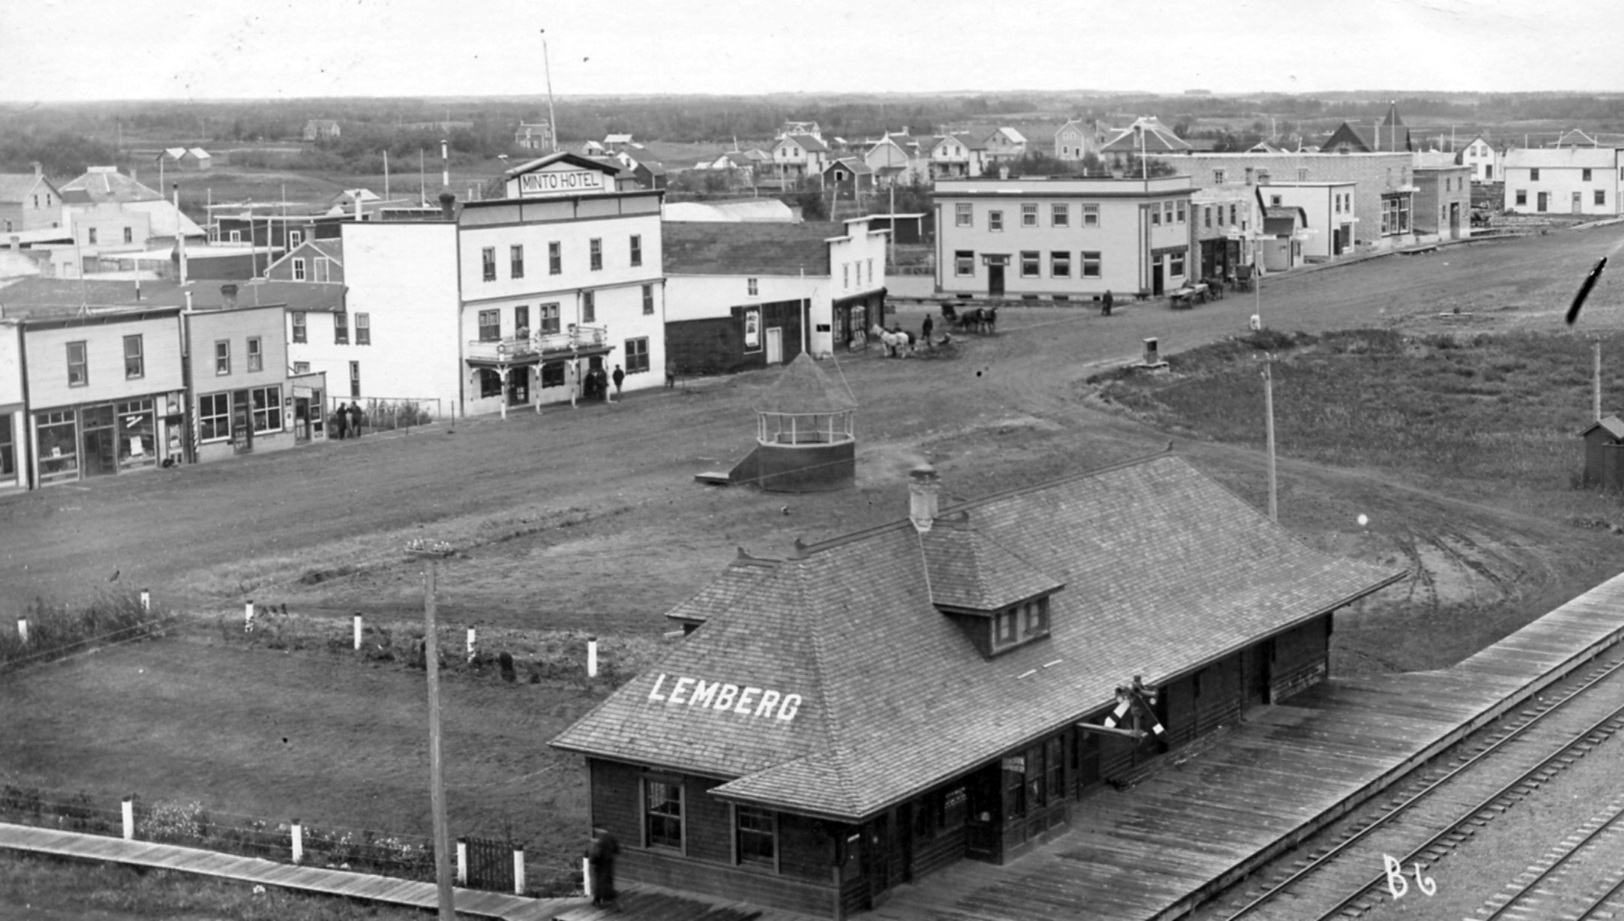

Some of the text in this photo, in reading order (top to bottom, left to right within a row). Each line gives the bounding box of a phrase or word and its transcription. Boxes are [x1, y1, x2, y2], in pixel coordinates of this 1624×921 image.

[522, 172, 599, 190] MINTO HOTEL
[648, 673, 802, 721] LEMBERG
